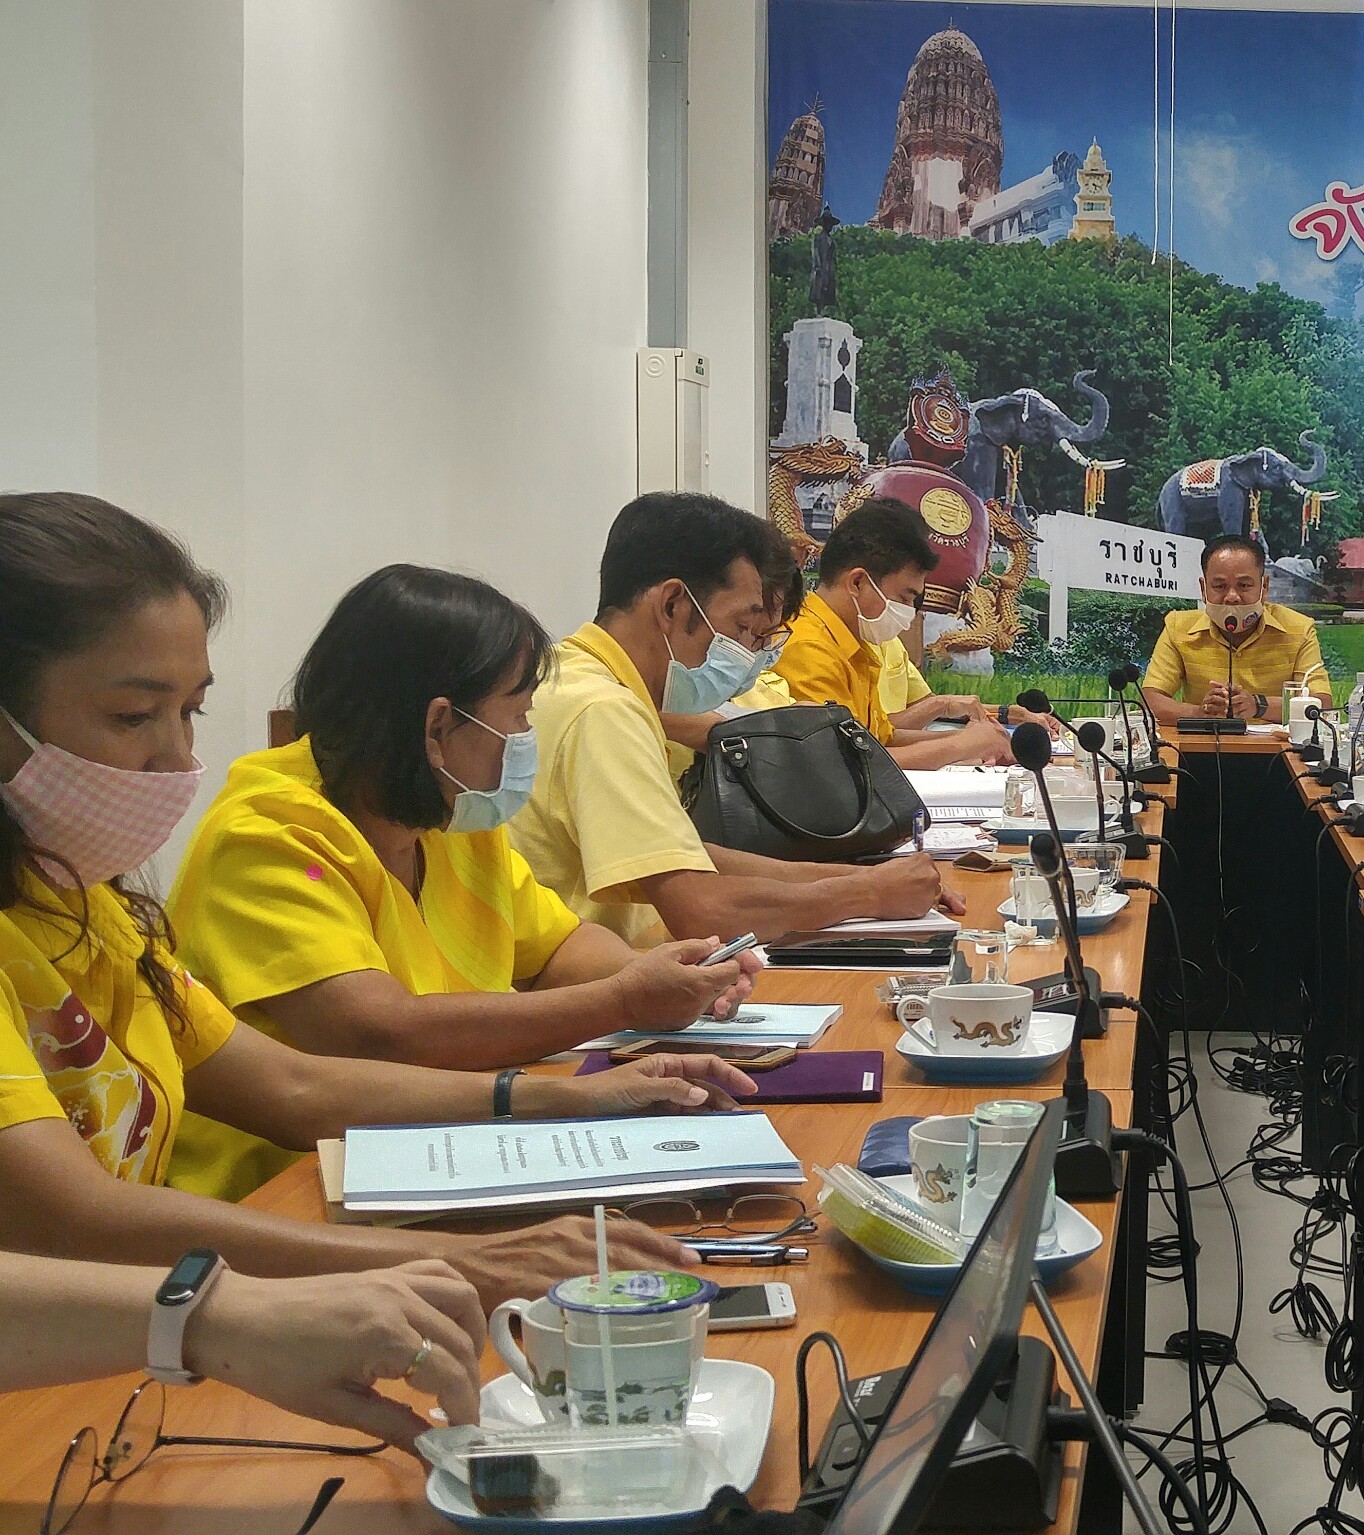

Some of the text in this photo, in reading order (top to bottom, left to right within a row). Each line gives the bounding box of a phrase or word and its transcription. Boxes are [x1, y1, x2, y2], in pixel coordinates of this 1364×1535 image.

[1099, 539, 1178, 579] ราชบุรี
[1105, 572, 1178, 591] RATCHABURI
